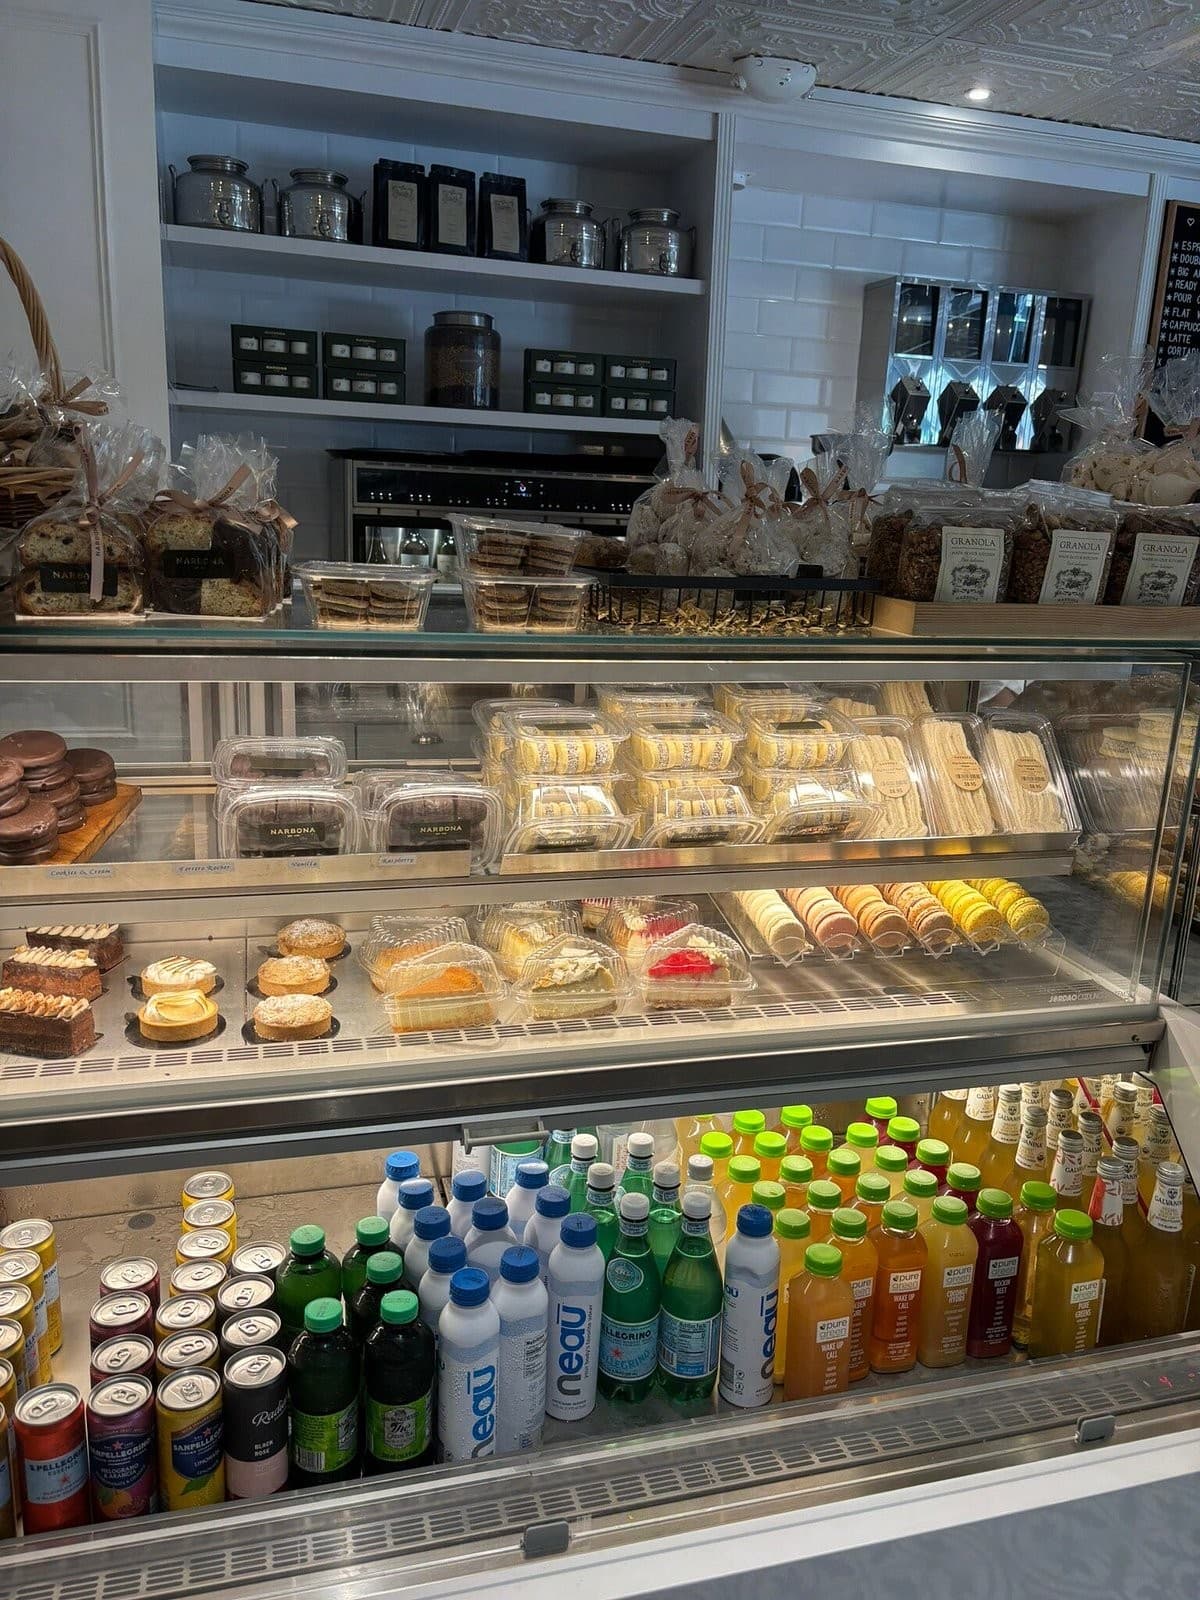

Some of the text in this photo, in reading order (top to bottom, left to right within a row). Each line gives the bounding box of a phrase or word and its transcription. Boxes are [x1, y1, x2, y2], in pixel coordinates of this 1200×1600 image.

[1177, 266, 1190, 277] BIG
[1174, 279, 1199, 291] READY
[1173, 291, 1193, 303] POUR
[1171, 306, 1191, 318] FLAT
[1168, 332, 1192, 344] LATTE
[951, 536, 996, 547] GRANOLA
[1059, 540, 1101, 551] GRANOLA
[1142, 543, 1188, 554] GRANOLA
[270, 827, 316, 836] NARBONA
[419, 825, 463, 834] NARBONA
[50, 869, 77, 877] Cookies
[953, 1266, 972, 1276] pure
[899, 1273, 919, 1282] pure
[892, 1281, 918, 1291] green
[1080, 1282, 1098, 1291] pure
[893, 1294, 908, 1302] WAKE
[826, 1319, 848, 1331] pure
[820, 1329, 847, 1340] green
[821, 1342, 836, 1352] WAKE
[826, 1351, 838, 1360] CALL
[254, 1440, 273, 1450] BLACK
[254, 1448, 270, 1456] ROSE
